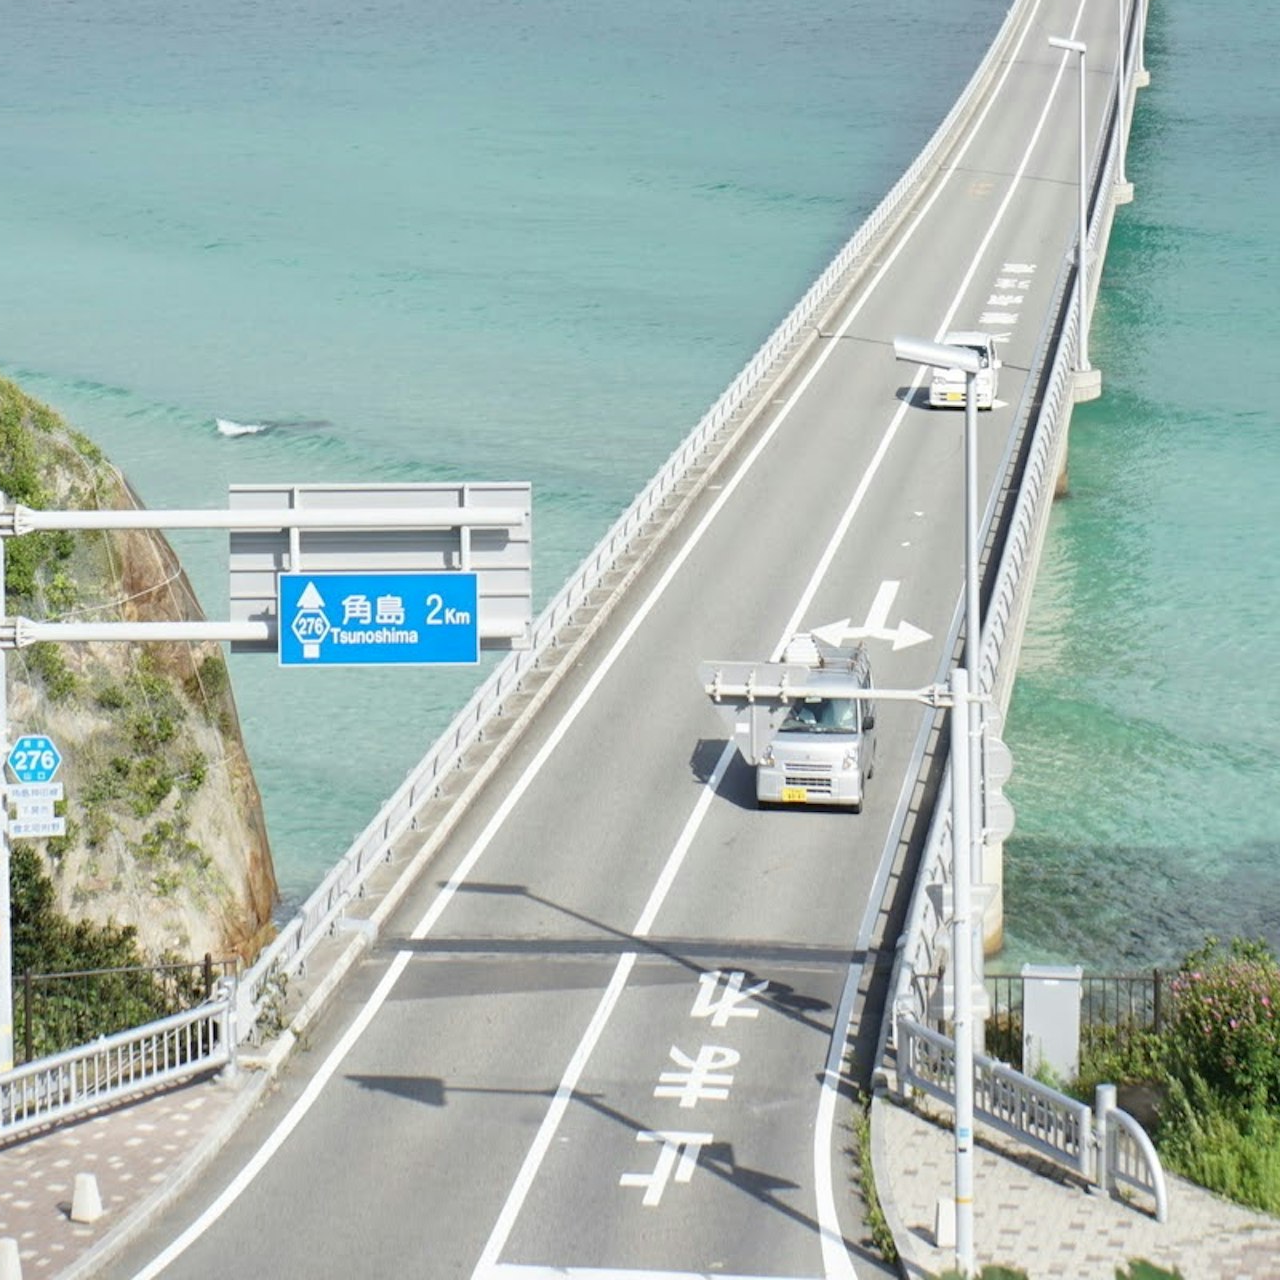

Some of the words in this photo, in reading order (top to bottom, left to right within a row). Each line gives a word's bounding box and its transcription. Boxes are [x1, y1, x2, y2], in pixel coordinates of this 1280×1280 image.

[341, 594, 405, 625] 角島
[298, 617, 324, 635] 276
[331, 627, 419, 644] Tsunoshima
[15, 750, 55, 770] 276
[619, 971, 770, 1207] 止まれ
